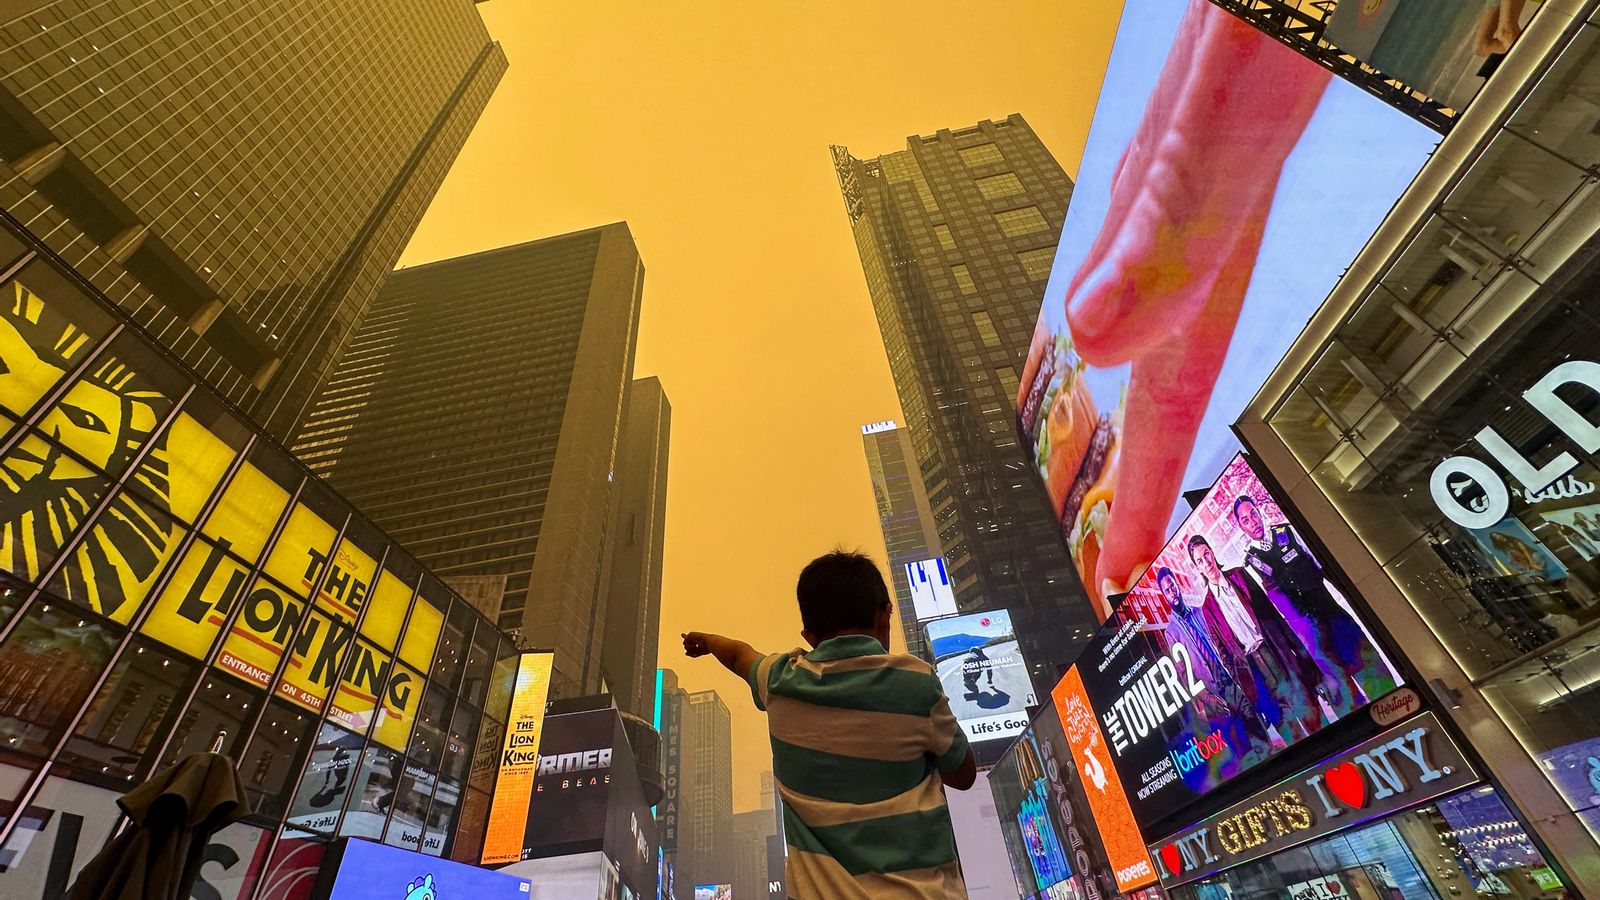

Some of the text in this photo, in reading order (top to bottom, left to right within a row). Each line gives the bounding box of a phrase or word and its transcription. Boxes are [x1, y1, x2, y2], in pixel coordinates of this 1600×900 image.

[1430, 361, 1600, 529] OLD
[302, 547, 366, 612] THE
[177, 537, 413, 711] LION KING
[992, 616, 1003, 625] LG
[980, 656, 1013, 667] NEUMAN
[222, 654, 353, 723] ENTRANCE ON 45TH STREET
[1114, 642, 1205, 745] TOWER 2
[516, 721, 534, 730] THE
[1373, 694, 1413, 721] Heritage
[509, 734, 534, 748] LION
[971, 719, 1029, 735] Life's Goo
[1102, 706, 1129, 757] THE
[502, 750, 534, 767] KING
[1141, 756, 1172, 784] ALL SEASONS
[1177, 730, 1228, 773] britbox
[666, 704, 678, 839] TIMES SQUARE
[1137, 769, 1178, 800] NOW STREAMING
[1152, 848, 1169, 880] I
[1217, 790, 1311, 855] GIFTS
[1306, 774, 1340, 819] I
